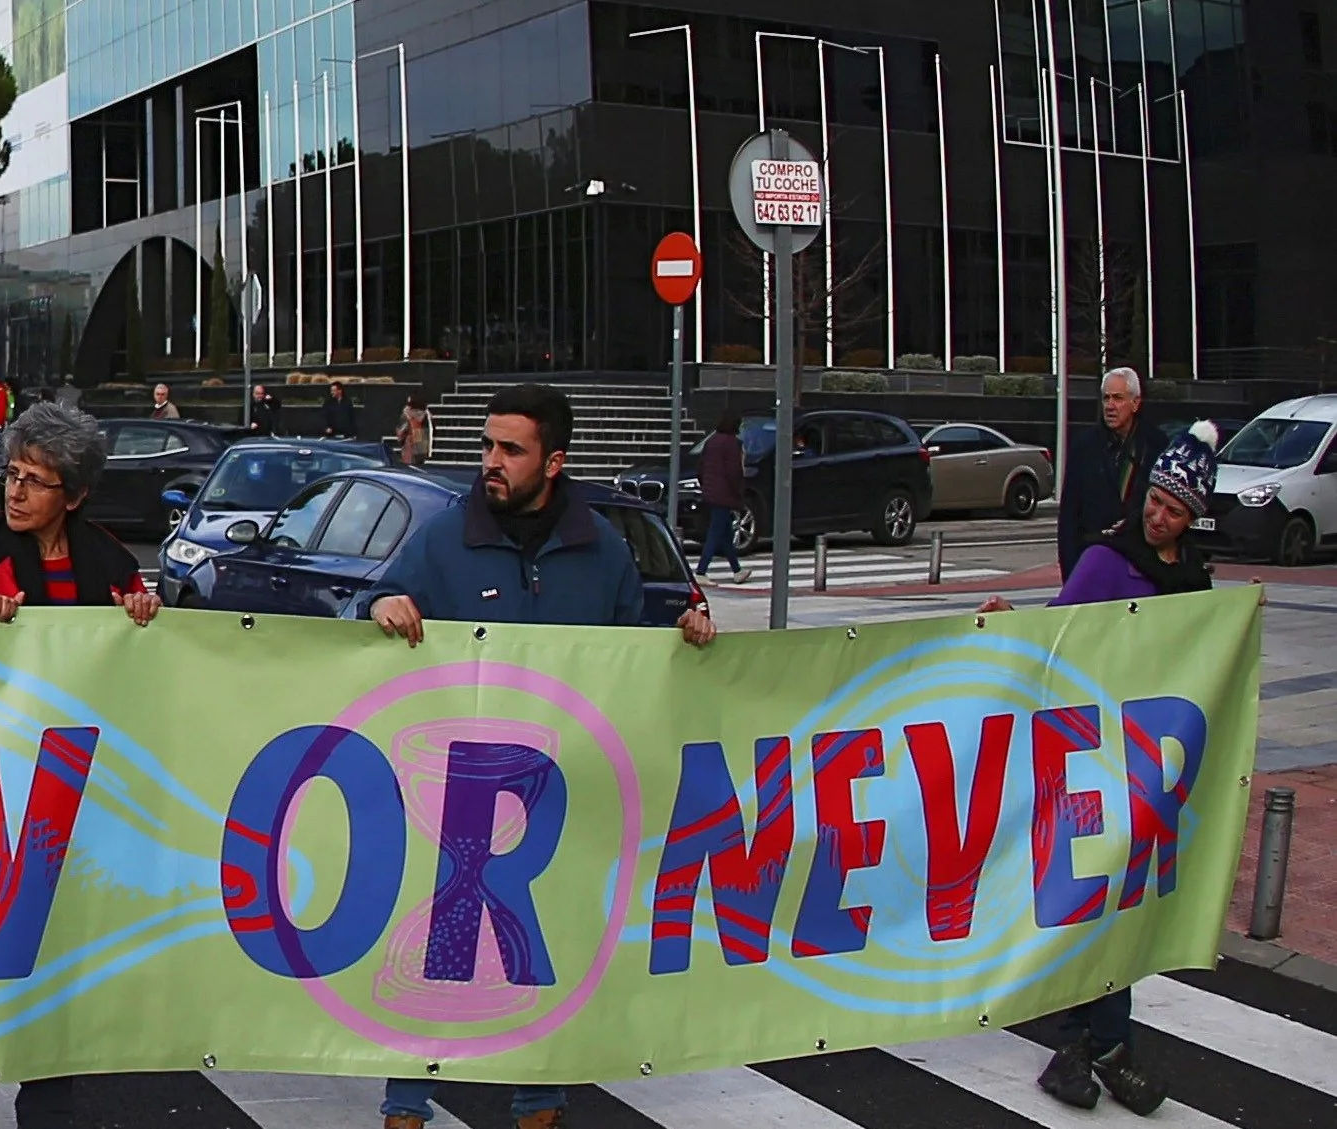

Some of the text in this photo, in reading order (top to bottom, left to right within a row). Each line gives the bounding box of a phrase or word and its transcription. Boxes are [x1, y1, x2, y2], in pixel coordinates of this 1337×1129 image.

[759, 163, 813, 177] COMPRO
[756, 176, 818, 191] TU COCHE
[757, 203, 819, 222] 642 63 62 17
[220, 723, 568, 987] OR
[648, 695, 1209, 977] NEVER
